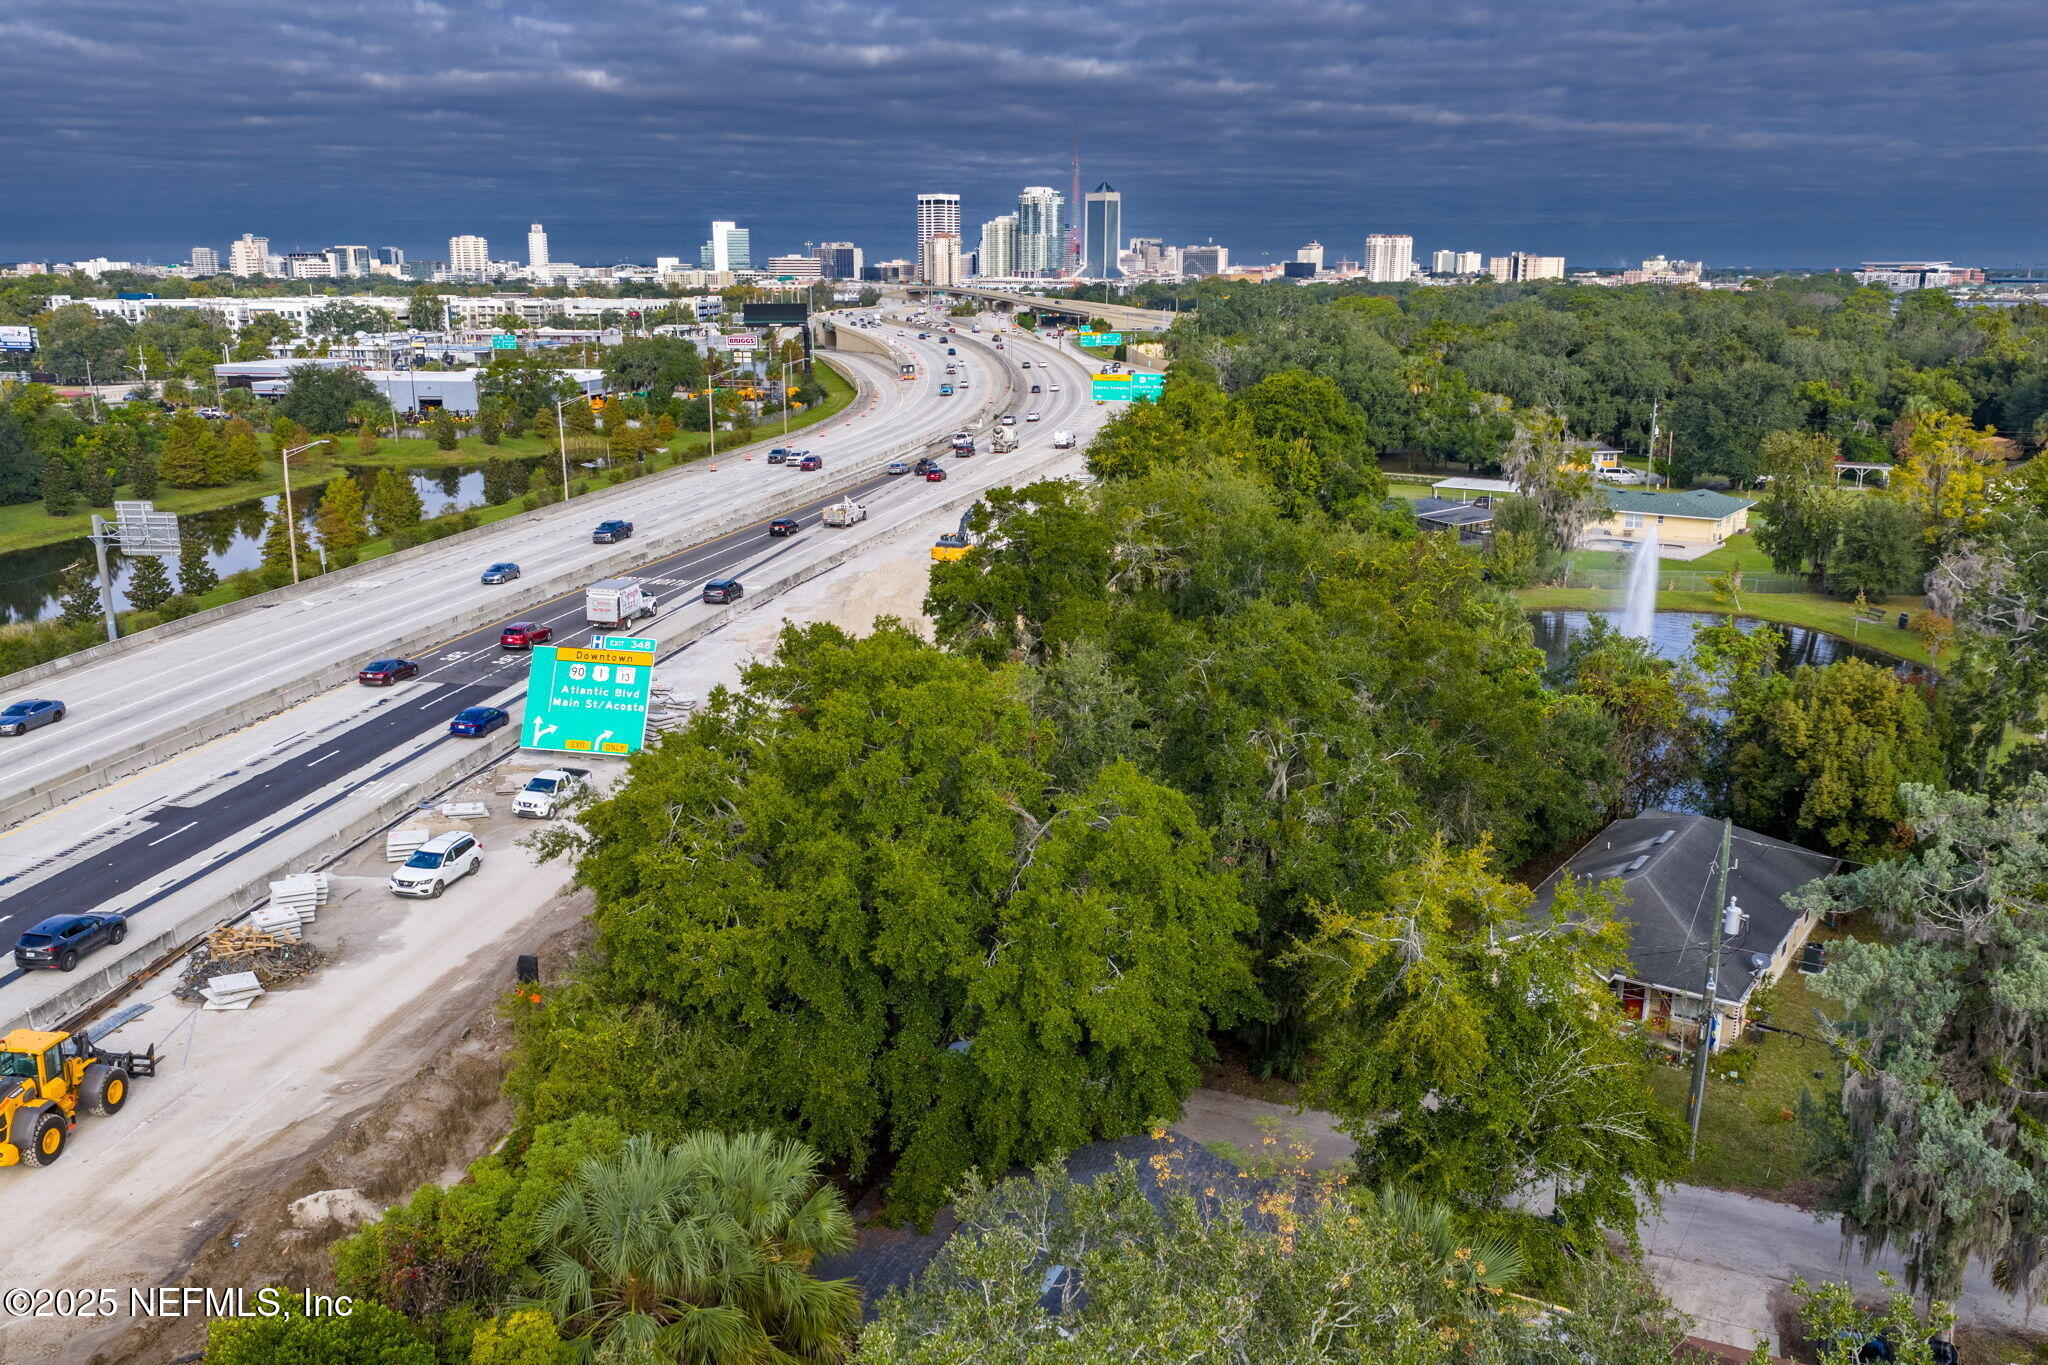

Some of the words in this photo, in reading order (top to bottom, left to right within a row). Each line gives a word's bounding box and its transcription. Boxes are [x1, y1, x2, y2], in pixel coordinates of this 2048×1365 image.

[630, 640, 651, 649] 348
[576, 651, 633, 663] Downtown
[571, 667, 585, 677] 90
[621, 673, 630, 682] 13
[561, 685, 609, 697] Atlantic
[615, 688, 640, 699] Blvd
[552, 698, 579, 707] Main
[585, 699, 645, 712] St/Acosta
[571, 741, 586, 749] EXIT
[605, 744, 624, 752] ONLY
